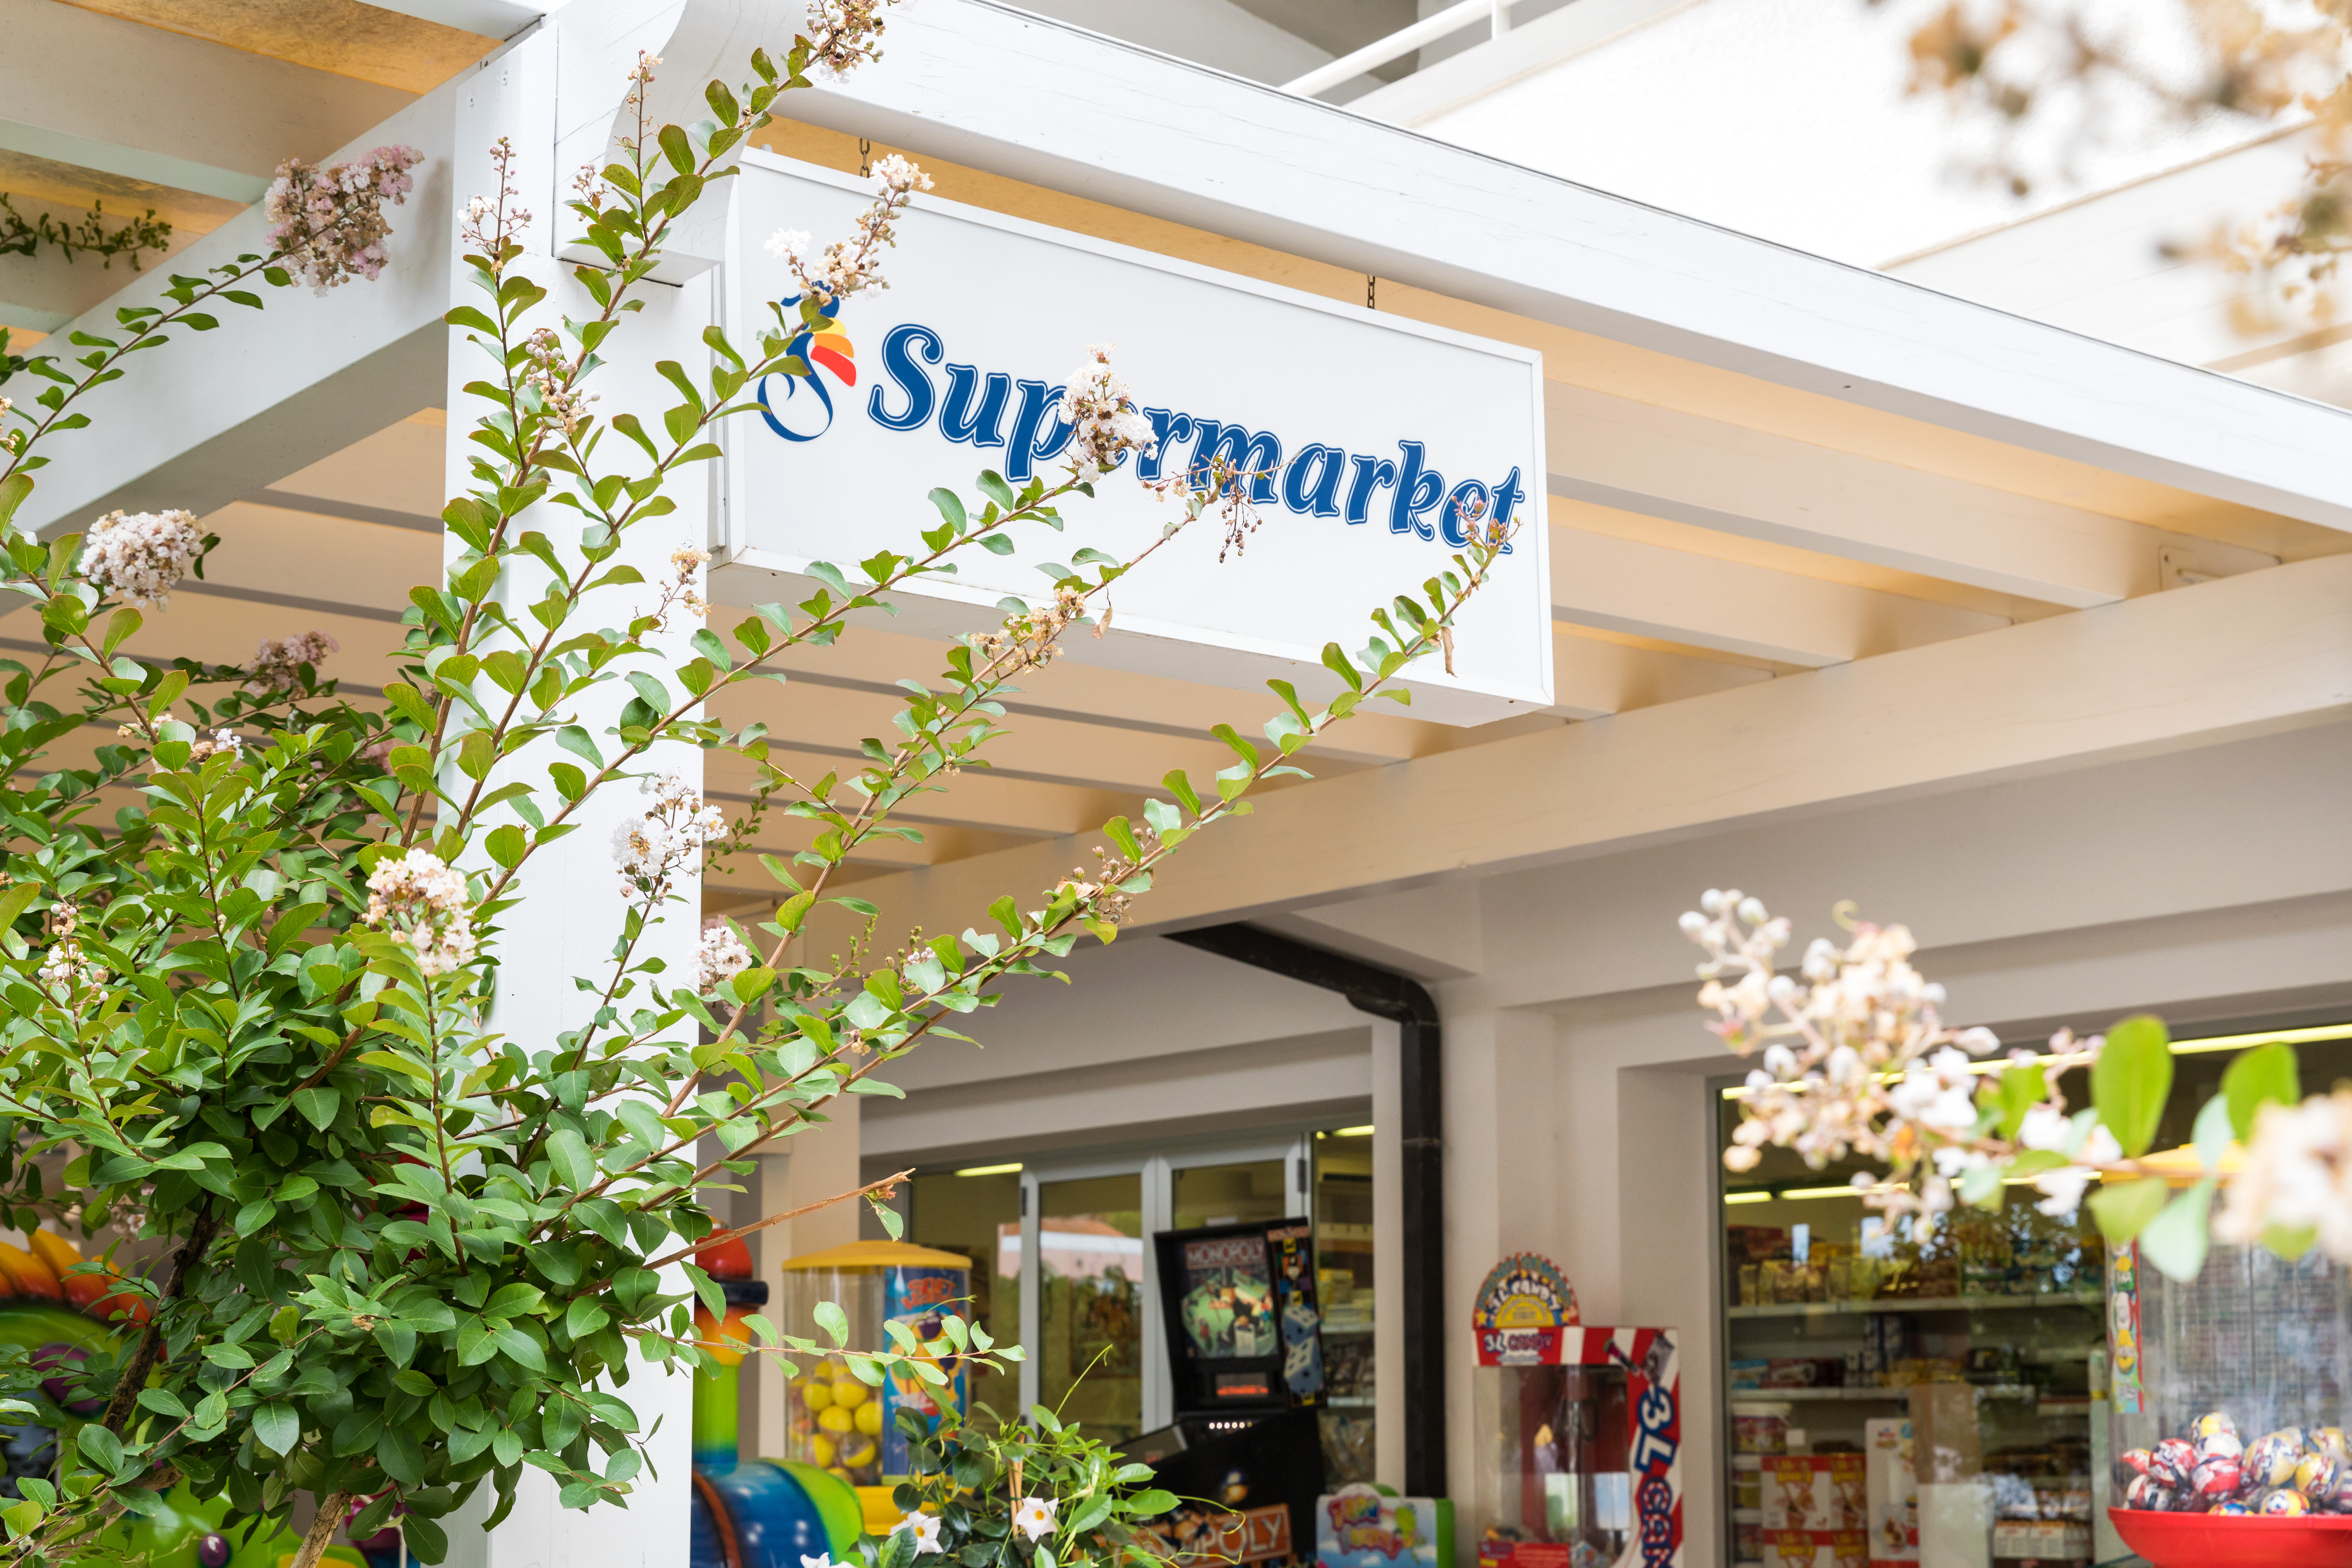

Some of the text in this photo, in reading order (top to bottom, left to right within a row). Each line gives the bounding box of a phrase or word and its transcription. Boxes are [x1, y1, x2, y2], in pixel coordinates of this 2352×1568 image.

[868, 324, 1525, 554] Suprmarket
[1188, 1241, 1264, 1265] MONOPOLY
[1634, 1387, 1677, 1473] 3L
